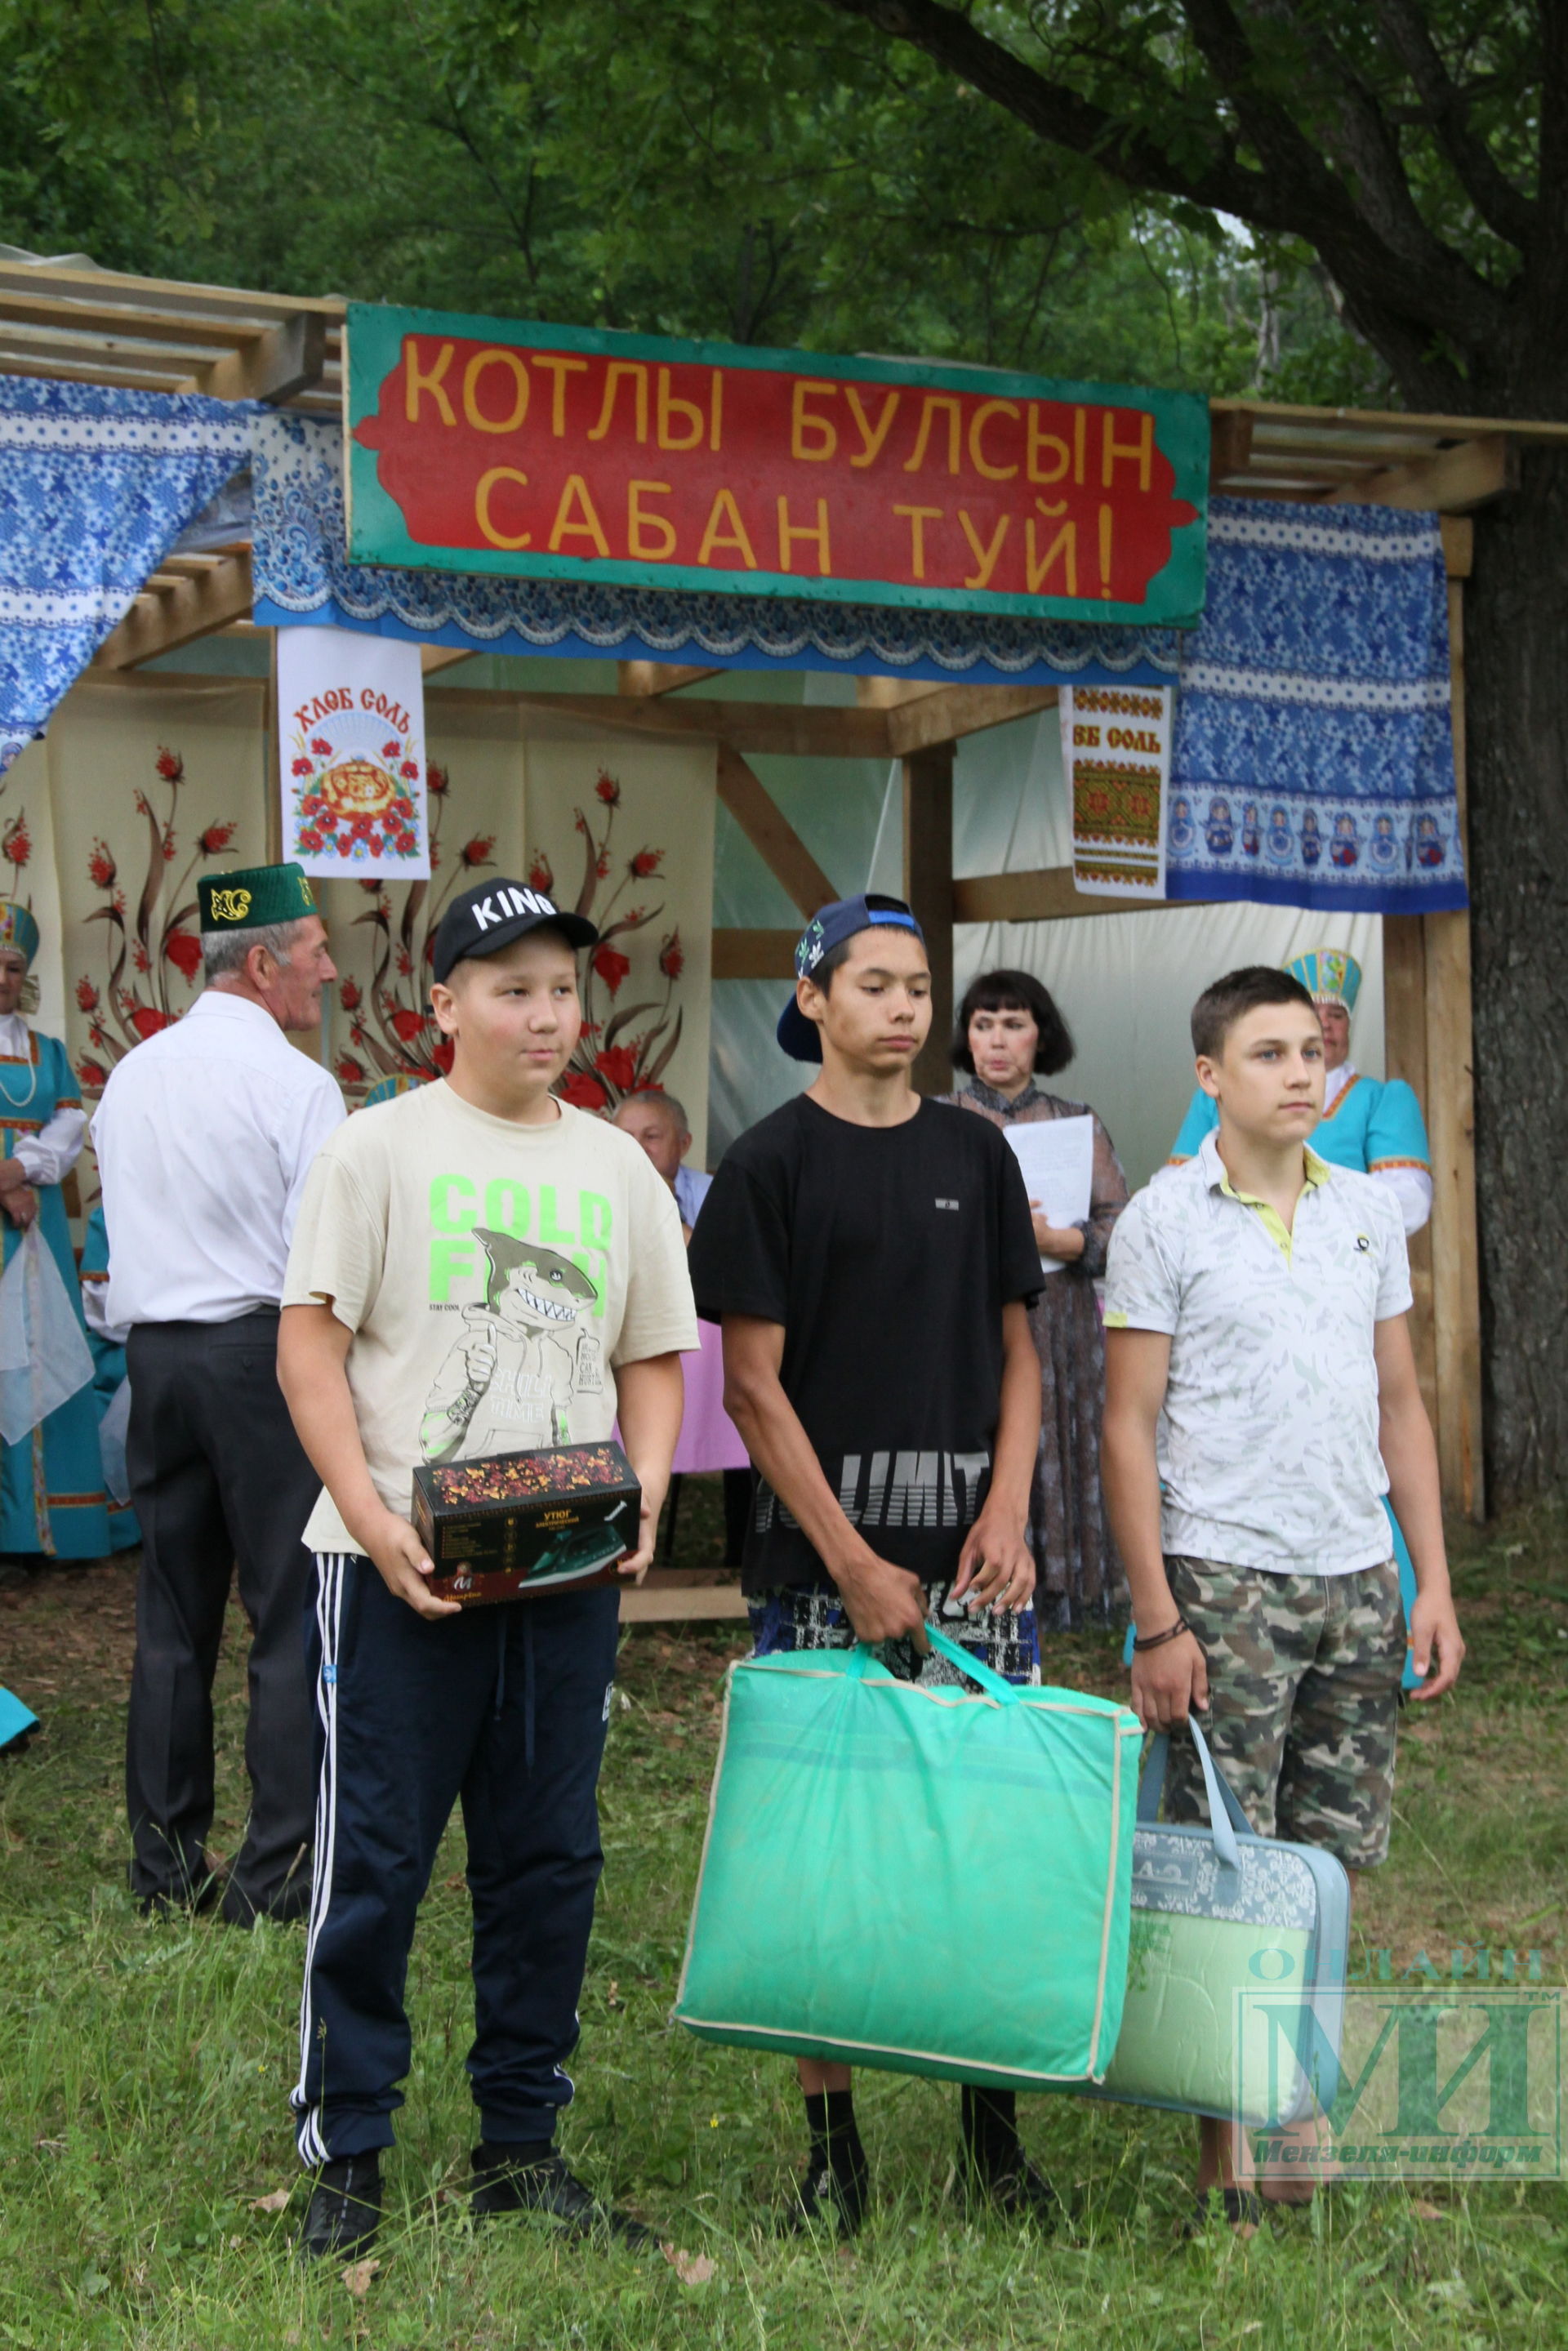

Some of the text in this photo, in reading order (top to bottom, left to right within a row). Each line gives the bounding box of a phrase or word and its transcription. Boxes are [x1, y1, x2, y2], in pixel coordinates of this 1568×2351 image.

[406, 341, 1153, 492] КОТЛЫ БУЛСЫН
[474, 466, 1112, 599] САБАН ТУЙ!
[360, 688, 411, 734] СОЛЬ
[1107, 727, 1161, 754] СОЛЬ
[429, 1173, 612, 1250] COLD
[429, 1240, 607, 1318] FH
[543, 1509, 572, 1521] УТЮГ
[840, 1450, 990, 1526] LIMIT
